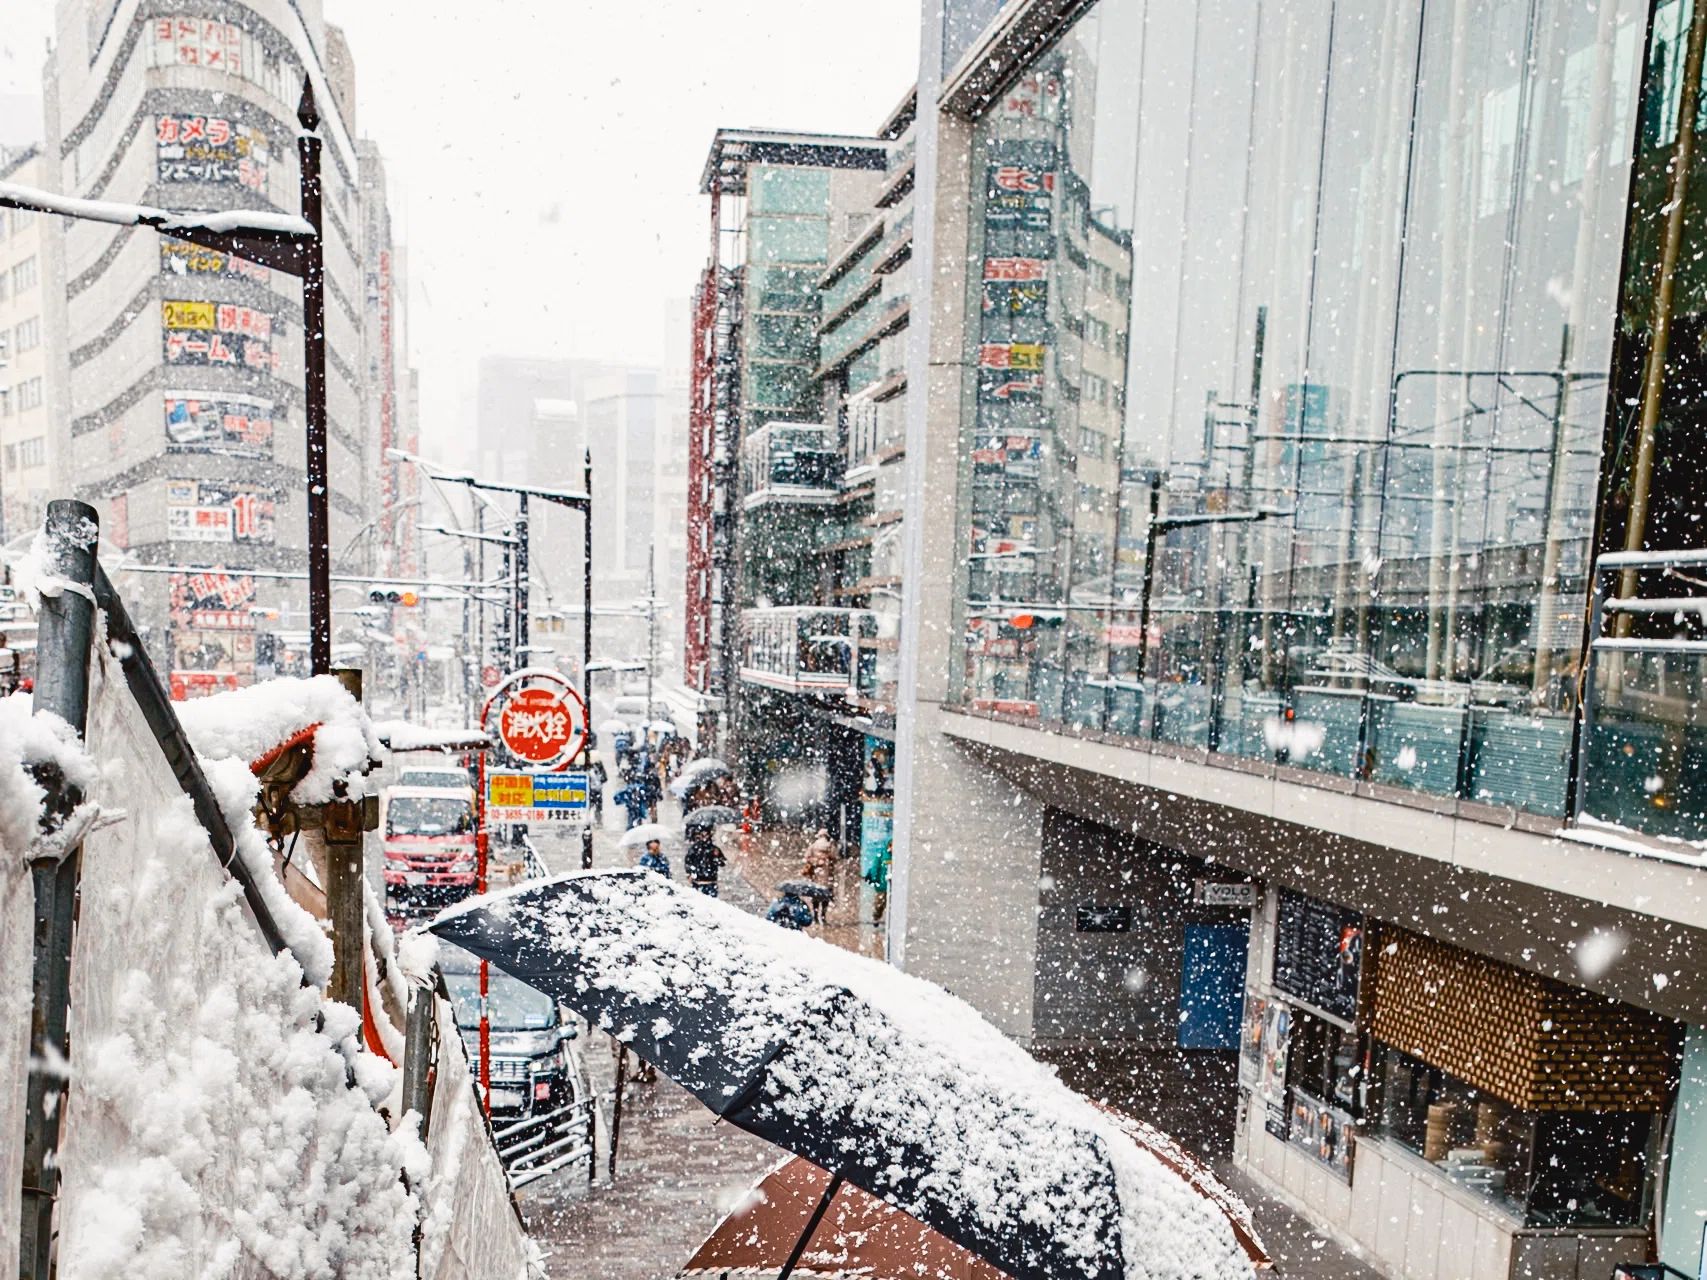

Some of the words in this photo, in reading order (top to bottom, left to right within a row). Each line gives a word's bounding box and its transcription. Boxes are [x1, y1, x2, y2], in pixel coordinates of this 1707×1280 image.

[157, 115, 230, 146] カメラ
[507, 711, 567, 740] 消火栓
[1211, 886, 1250, 897] VOLO
